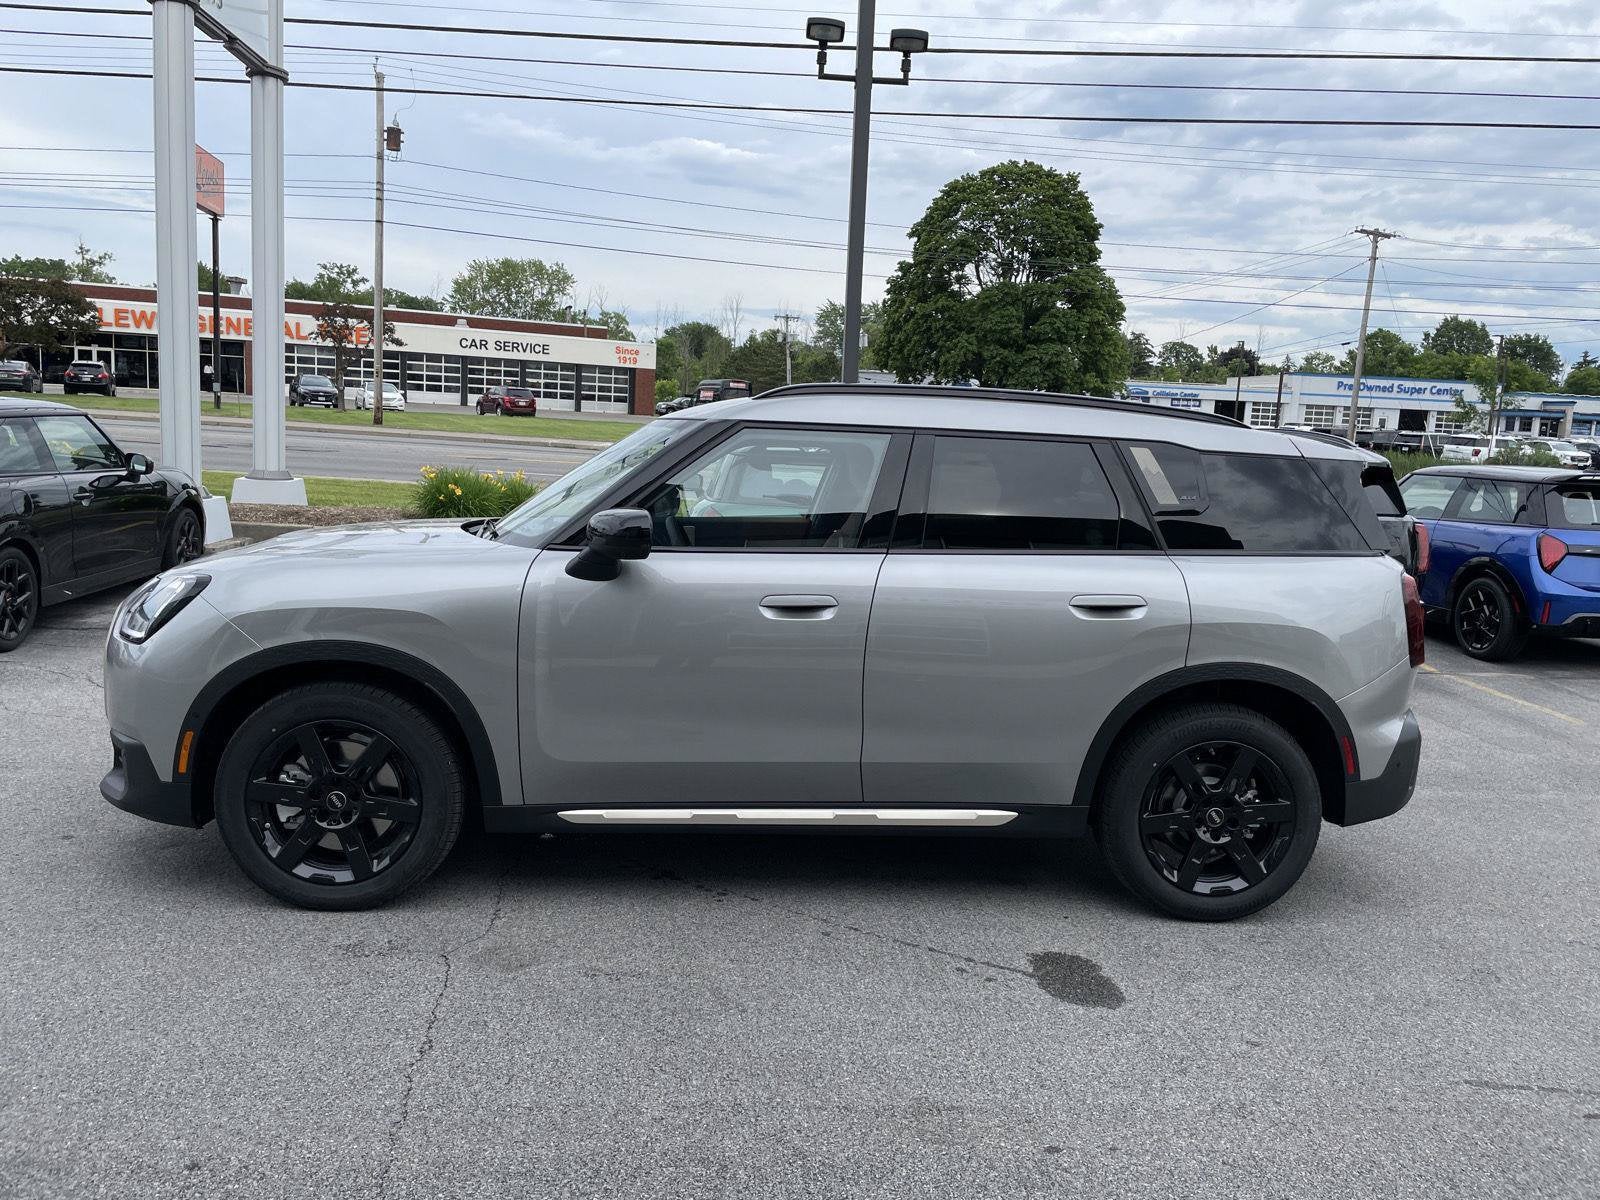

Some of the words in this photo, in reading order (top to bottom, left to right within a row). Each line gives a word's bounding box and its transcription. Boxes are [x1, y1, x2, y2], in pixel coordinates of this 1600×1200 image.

[97, 308, 157, 329] LEW
[198, 313, 309, 341] GENEAL
[459, 337, 489, 351] CAR
[494, 340, 550, 355] SERVICE
[615, 345, 640, 356] Since
[617, 355, 638, 365] 1919
[1152, 390, 1179, 398] Collision
[1396, 384, 1428, 397] Super
[1429, 385, 1465, 397] Center
